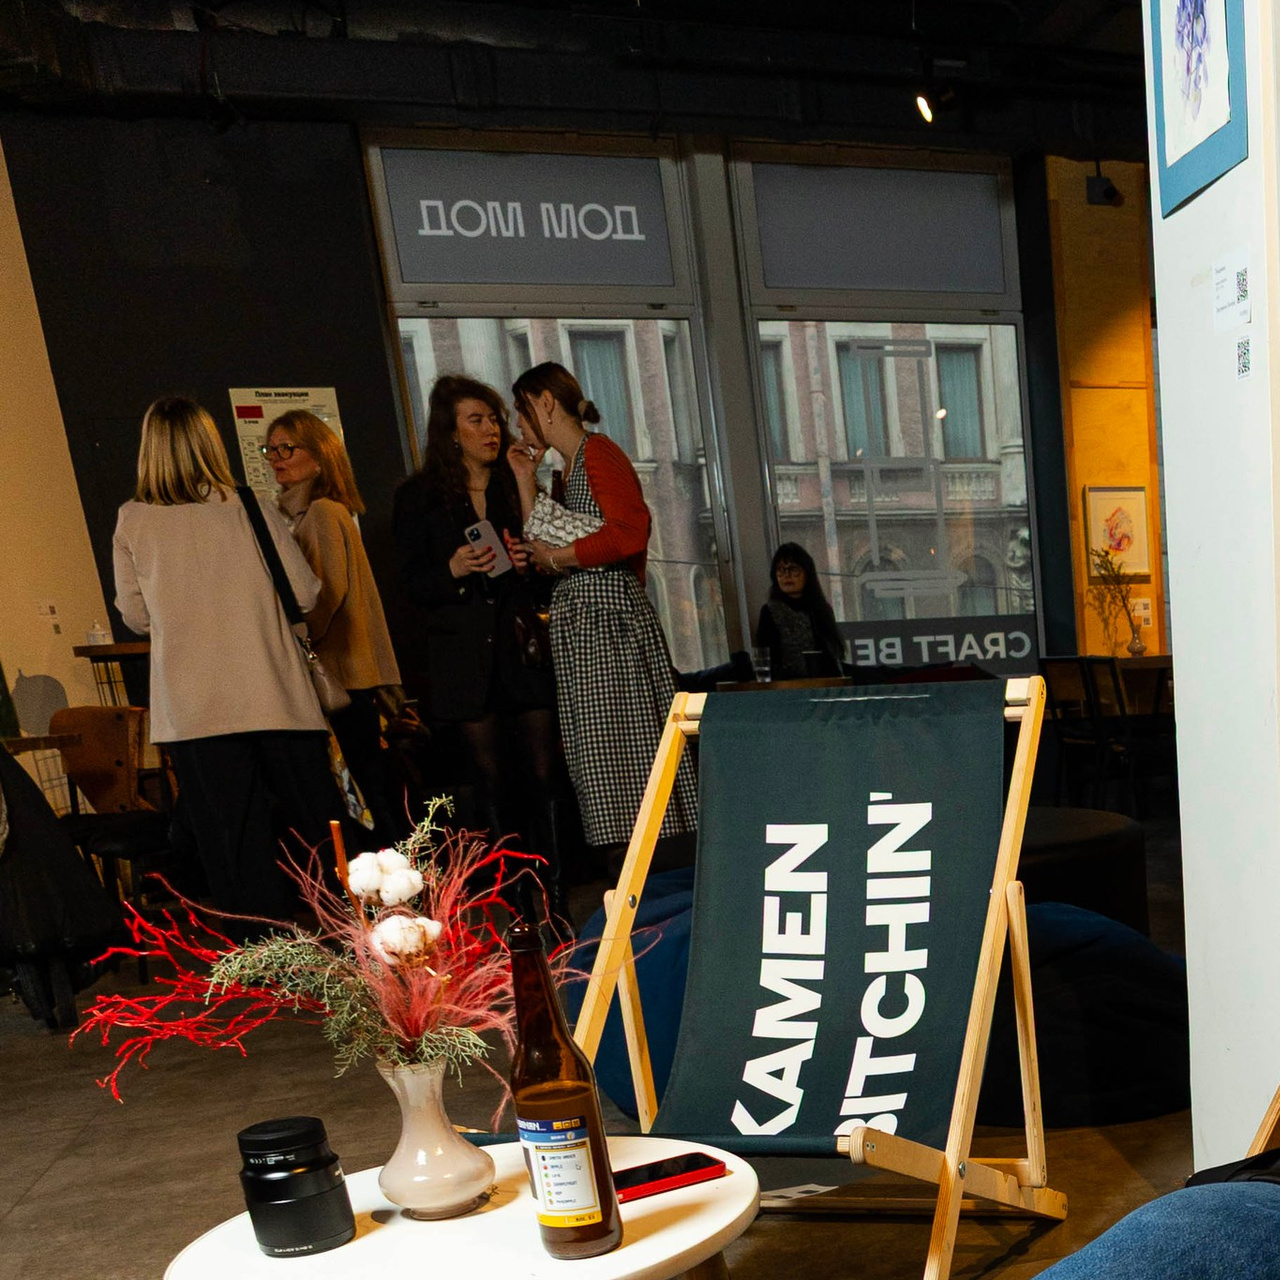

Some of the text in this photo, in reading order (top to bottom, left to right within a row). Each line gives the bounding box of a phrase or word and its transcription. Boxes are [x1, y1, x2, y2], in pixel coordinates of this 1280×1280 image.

[418, 199, 646, 240] ДОМ МОД
[731, 823, 829, 1135] KAMEN
